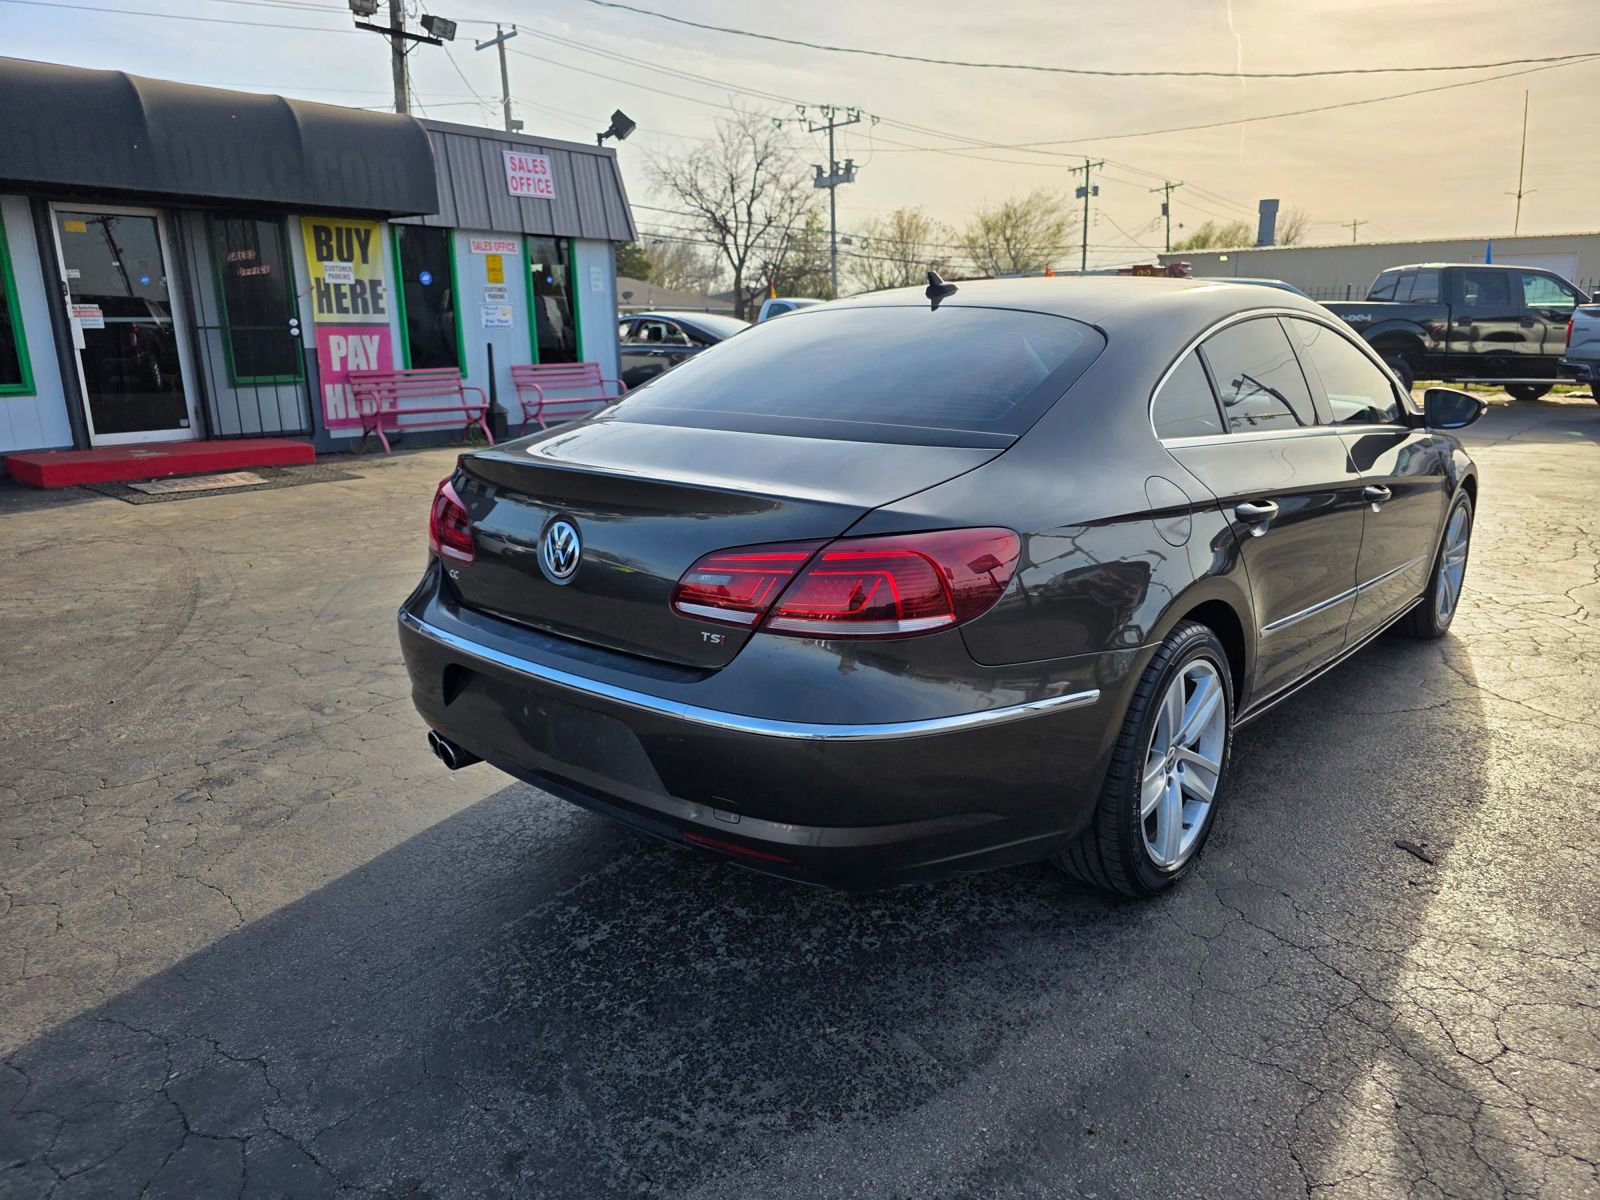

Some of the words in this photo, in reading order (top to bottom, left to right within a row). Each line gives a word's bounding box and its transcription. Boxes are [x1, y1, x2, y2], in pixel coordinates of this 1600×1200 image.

[510, 156, 547, 175] SALES
[511, 176, 553, 194] OFFICE
[313, 225, 371, 264] BUY
[472, 241, 492, 251] SALES
[494, 241, 516, 252] OFFICE
[328, 273, 351, 281] PARKING
[315, 278, 386, 314] HERE
[329, 335, 380, 371] PAY
